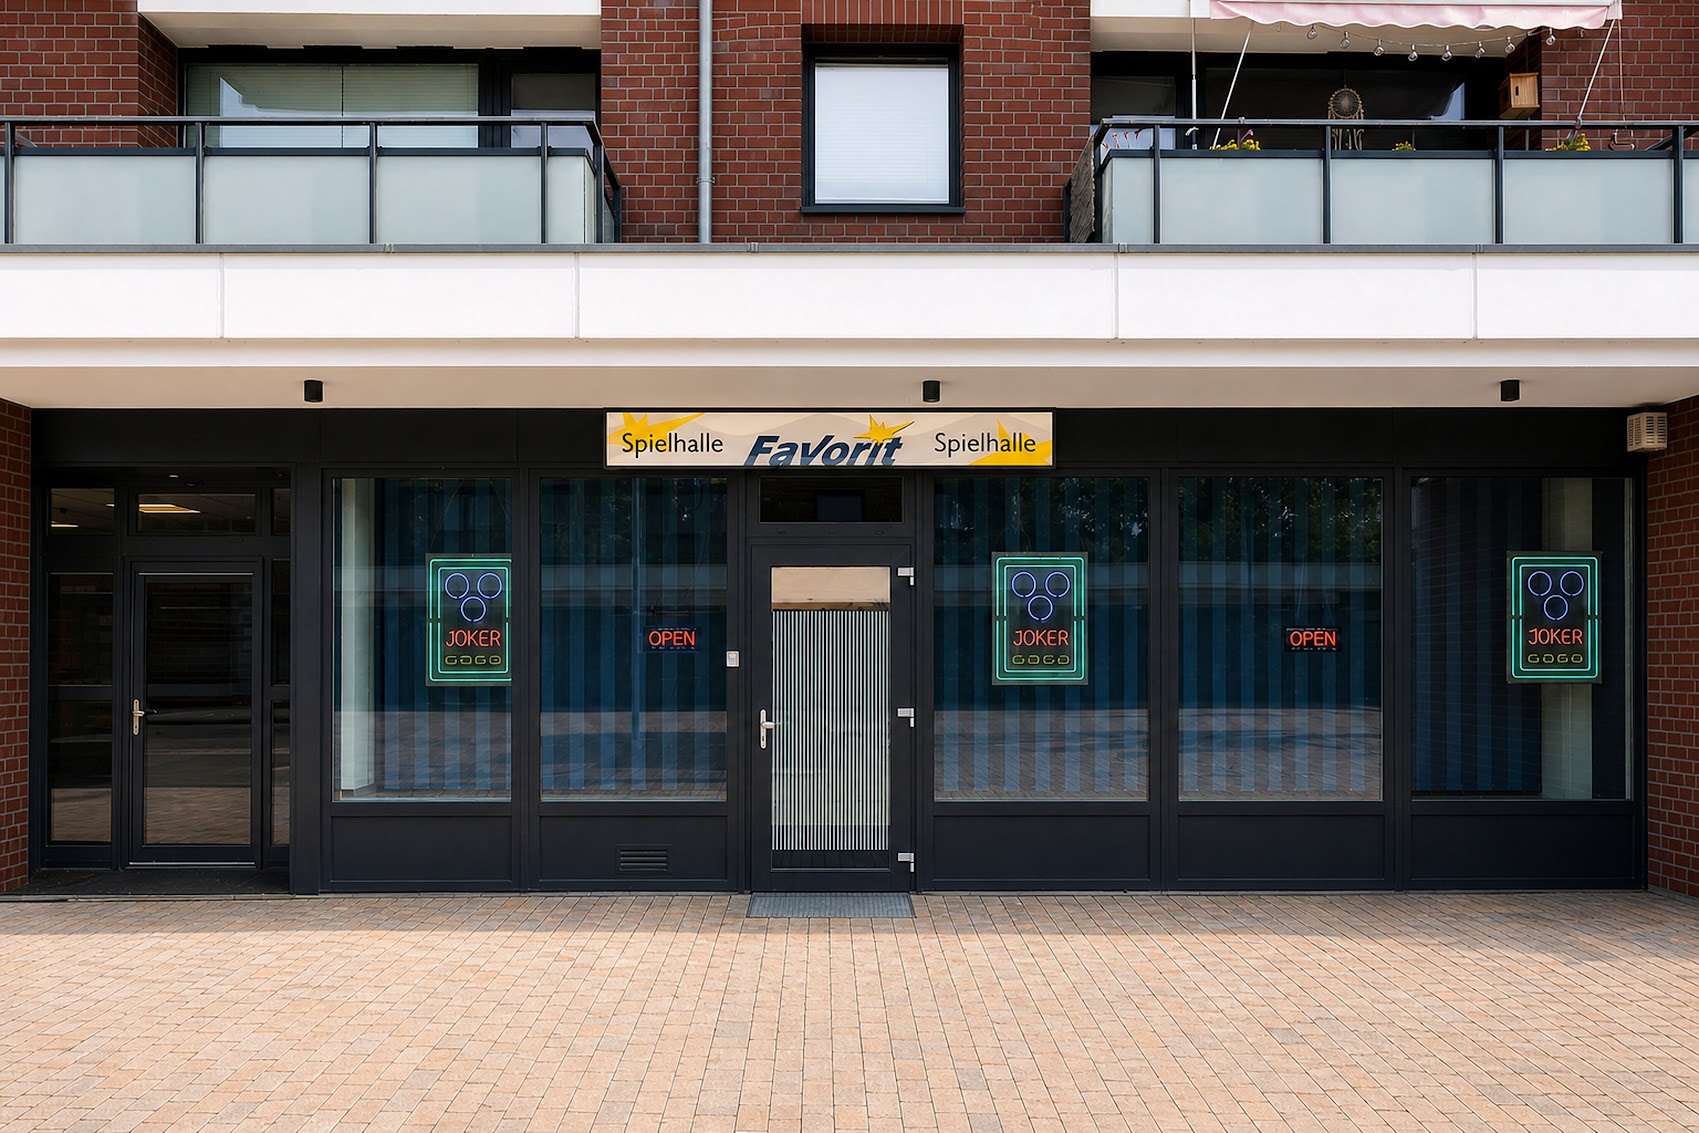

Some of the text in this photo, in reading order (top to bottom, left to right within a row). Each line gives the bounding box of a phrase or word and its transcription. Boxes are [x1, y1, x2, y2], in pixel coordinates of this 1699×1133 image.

[621, 432, 724, 458] Spielhalle
[934, 432, 1037, 457] Spielhalle
[445, 629, 501, 647] JOKER
[648, 630, 696, 646] OPEN
[1012, 629, 1069, 646] JOKER
[1289, 630, 1337, 647] OPEN
[1528, 627, 1583, 645] JOKER
